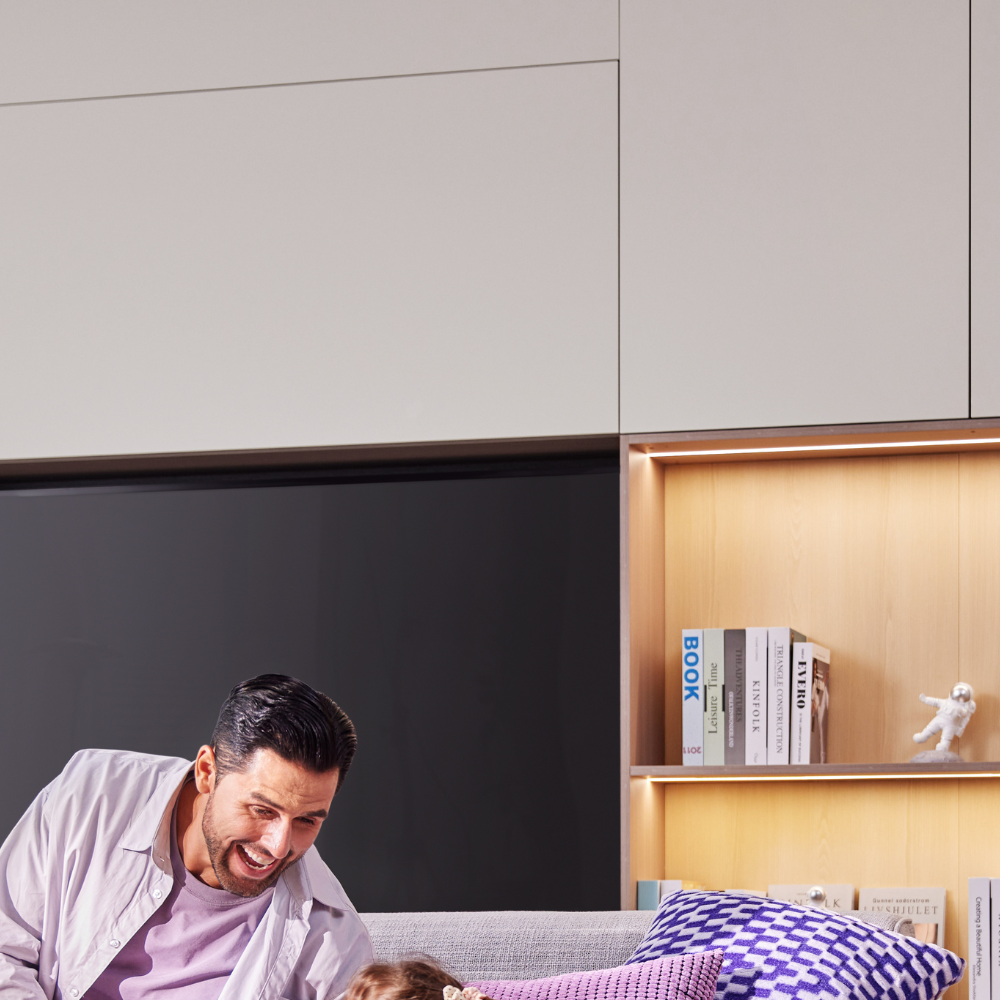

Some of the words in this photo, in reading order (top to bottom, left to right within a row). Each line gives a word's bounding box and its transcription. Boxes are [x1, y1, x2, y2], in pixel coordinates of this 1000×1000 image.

[684, 636, 699, 701] BOOK
[708, 662, 718, 690] Time
[796, 661, 807, 709] EVERO
[708, 696, 718, 734] Leisure
[752, 680, 760, 732] KINFOLK
